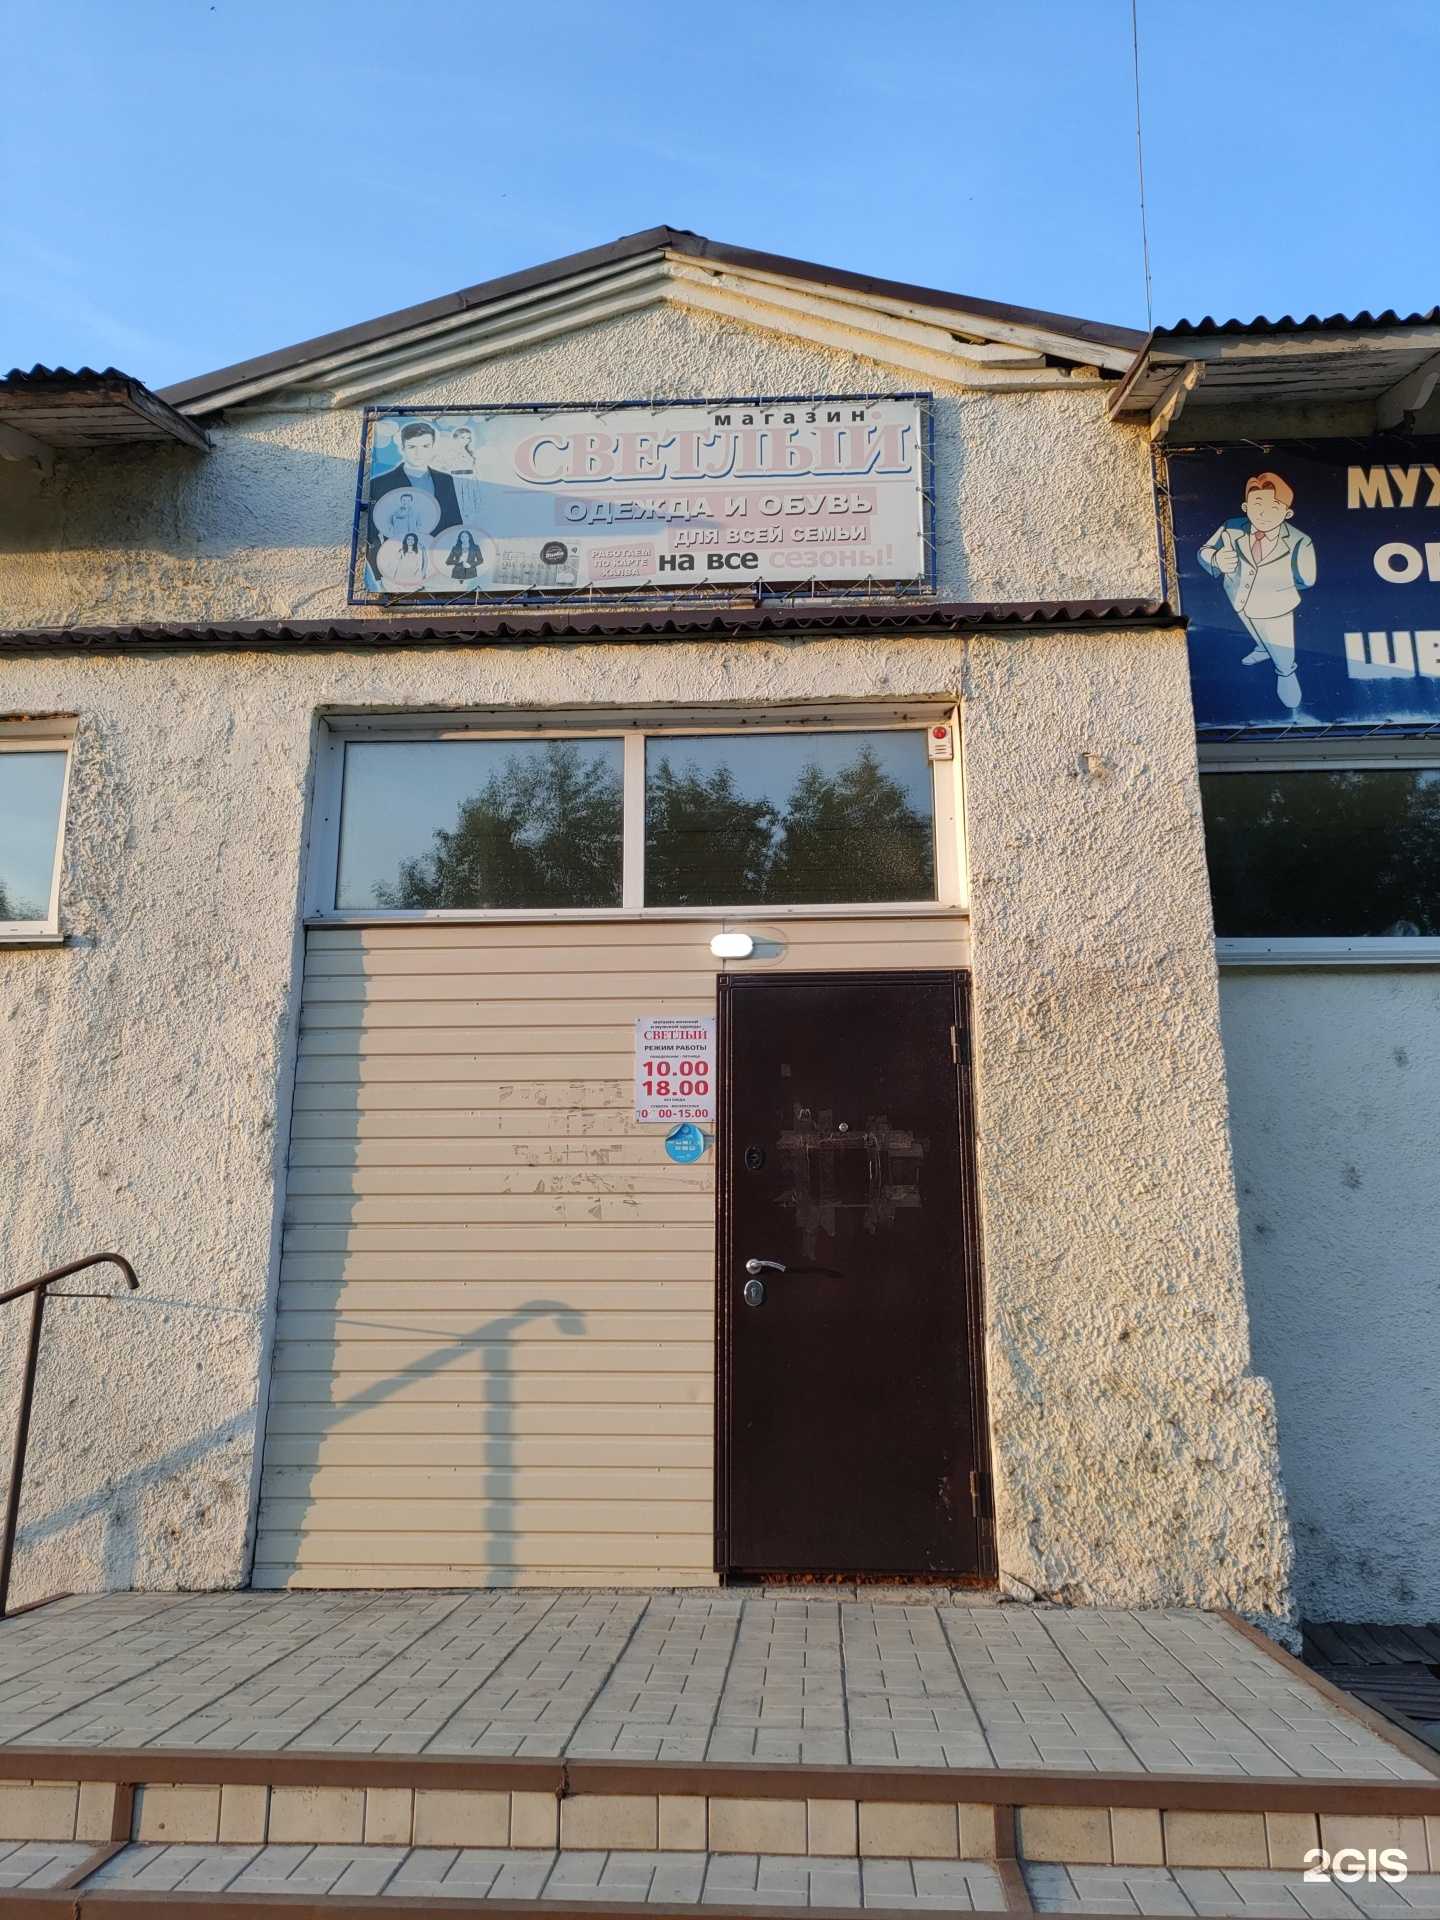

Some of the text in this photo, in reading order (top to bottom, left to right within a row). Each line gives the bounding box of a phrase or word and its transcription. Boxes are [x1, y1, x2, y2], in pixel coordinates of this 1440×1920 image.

[714, 410, 865, 426] магазин
[513, 411, 913, 485] СВЕТЛЫЙ
[565, 494, 873, 524] ОДЕЖДА И ОБУВЬ
[673, 525, 868, 548] ДЛЯ ВСЕЙ СЕМЬИ
[658, 544, 895, 572] на все сезоны!
[643, 1028, 708, 1040] СВЕТЛЫЙ
[642, 1061, 709, 1077] 10.00
[642, 1080, 709, 1097] 18.00
